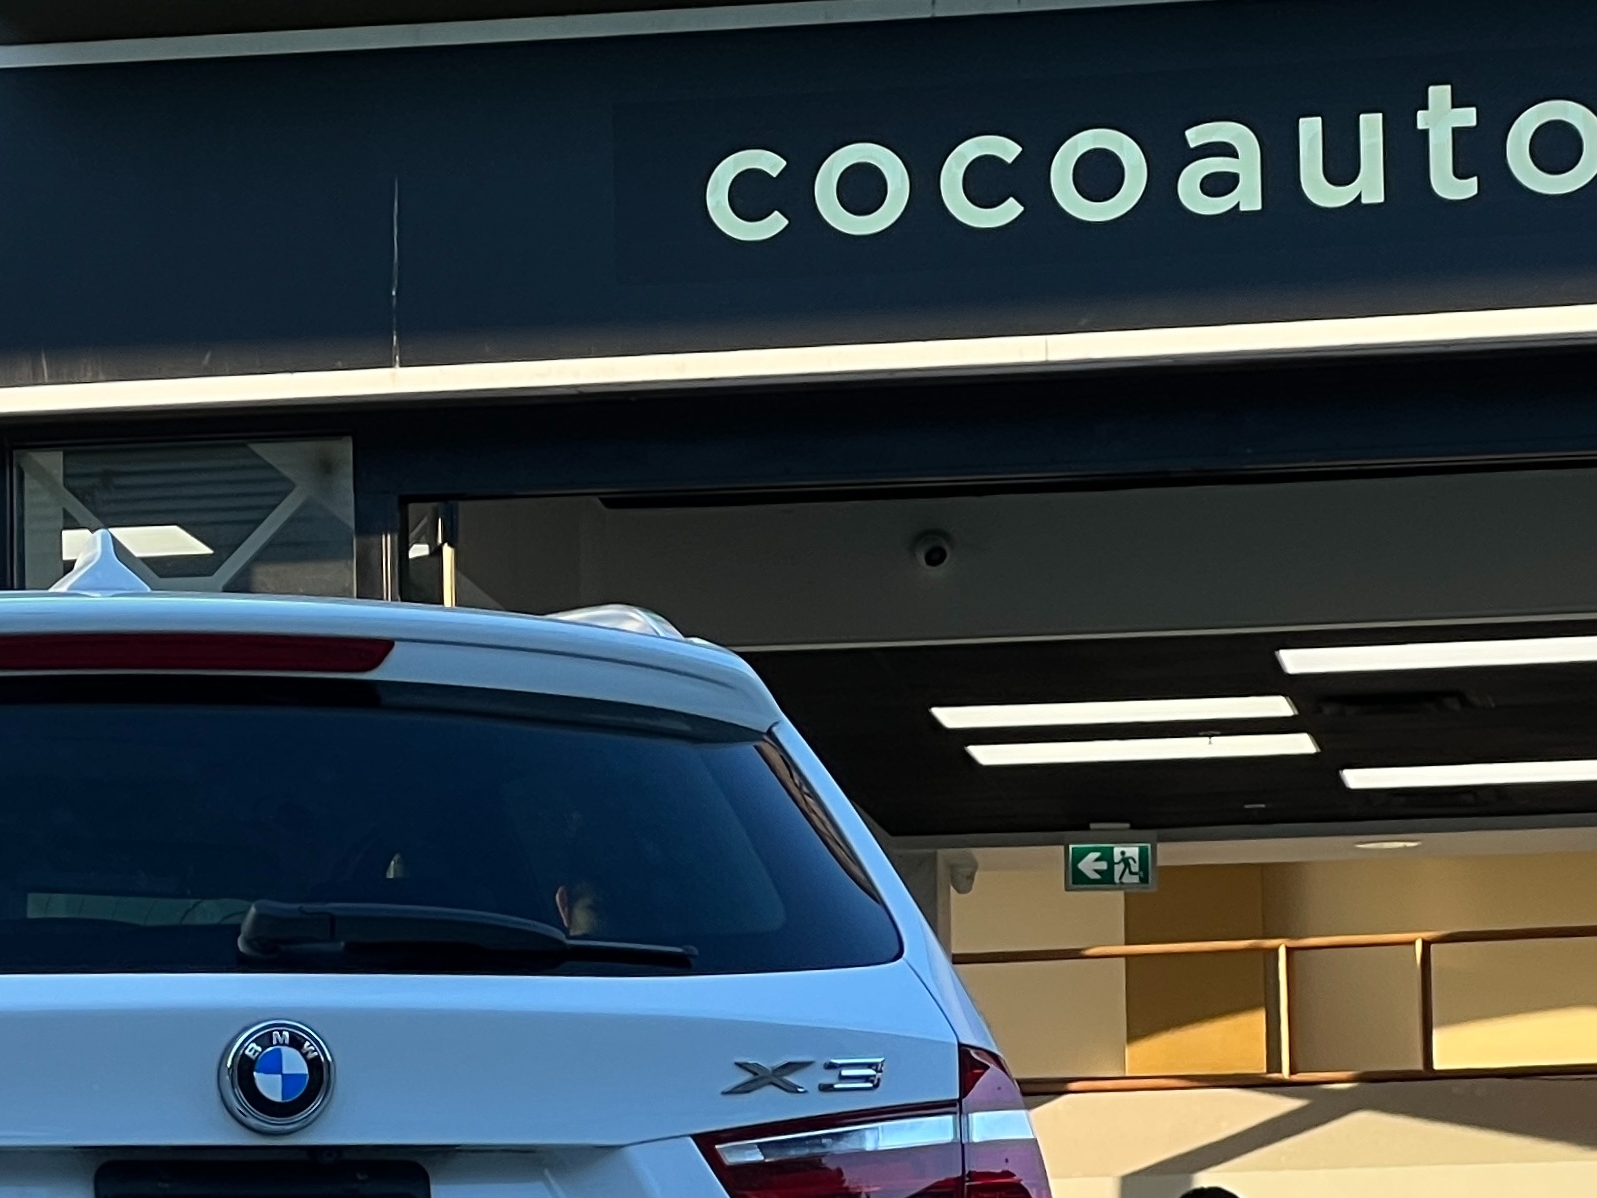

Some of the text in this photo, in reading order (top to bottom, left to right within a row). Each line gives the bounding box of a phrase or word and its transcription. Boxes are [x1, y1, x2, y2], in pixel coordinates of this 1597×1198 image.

[705, 85, 1597, 241] cocoauto
[244, 1031, 319, 1060] BMW
[720, 1057, 885, 1095] X3
